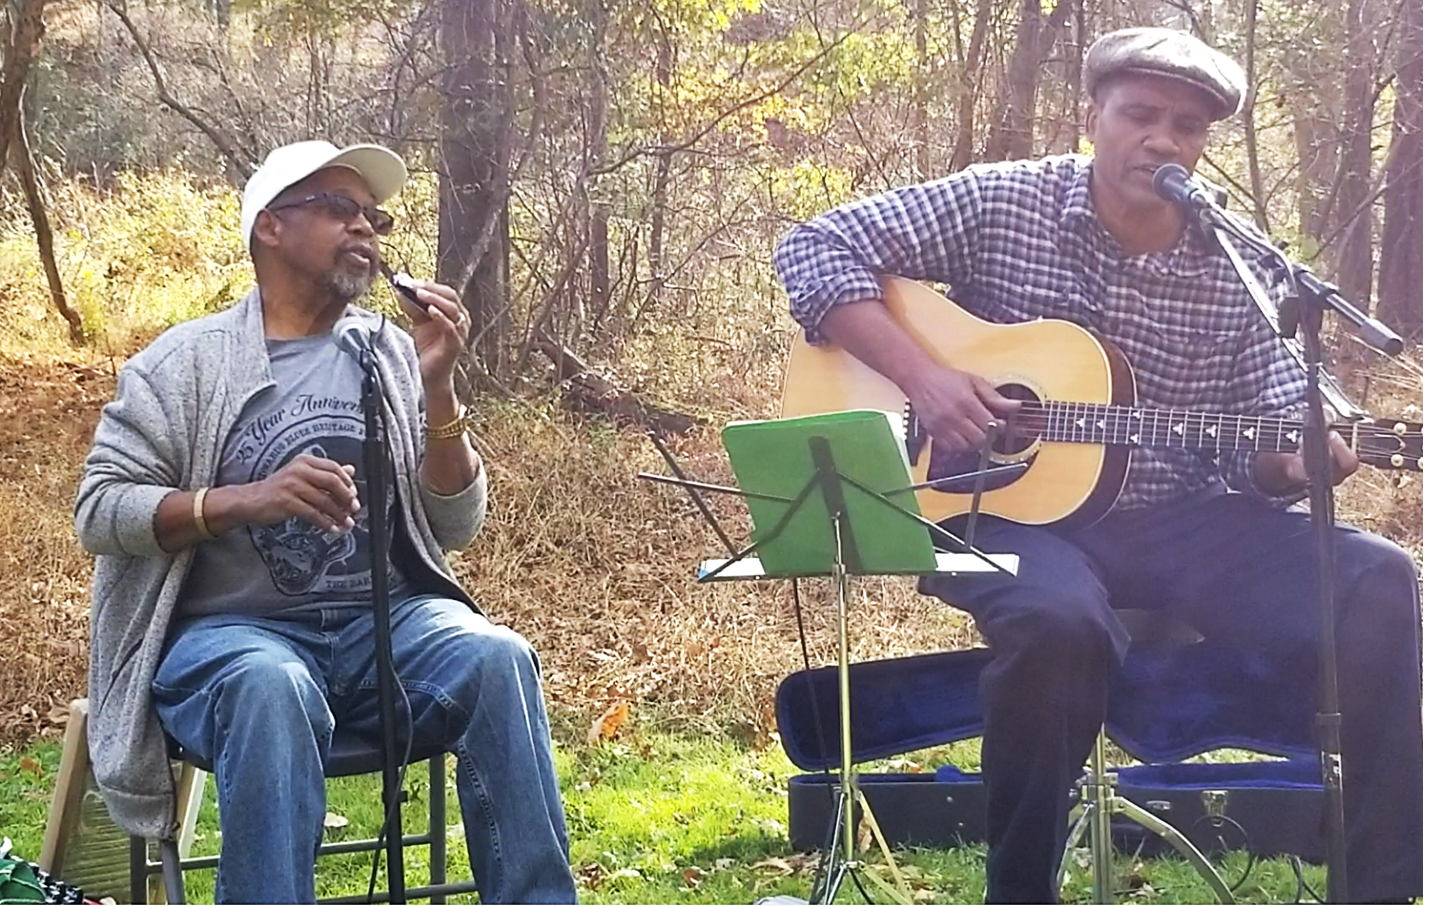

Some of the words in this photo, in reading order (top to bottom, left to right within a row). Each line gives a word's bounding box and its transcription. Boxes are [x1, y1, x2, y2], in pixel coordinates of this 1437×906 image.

[236, 440, 255, 465] 25
[247, 408, 286, 446] Year
[312, 422, 357, 433] HERITAGE
